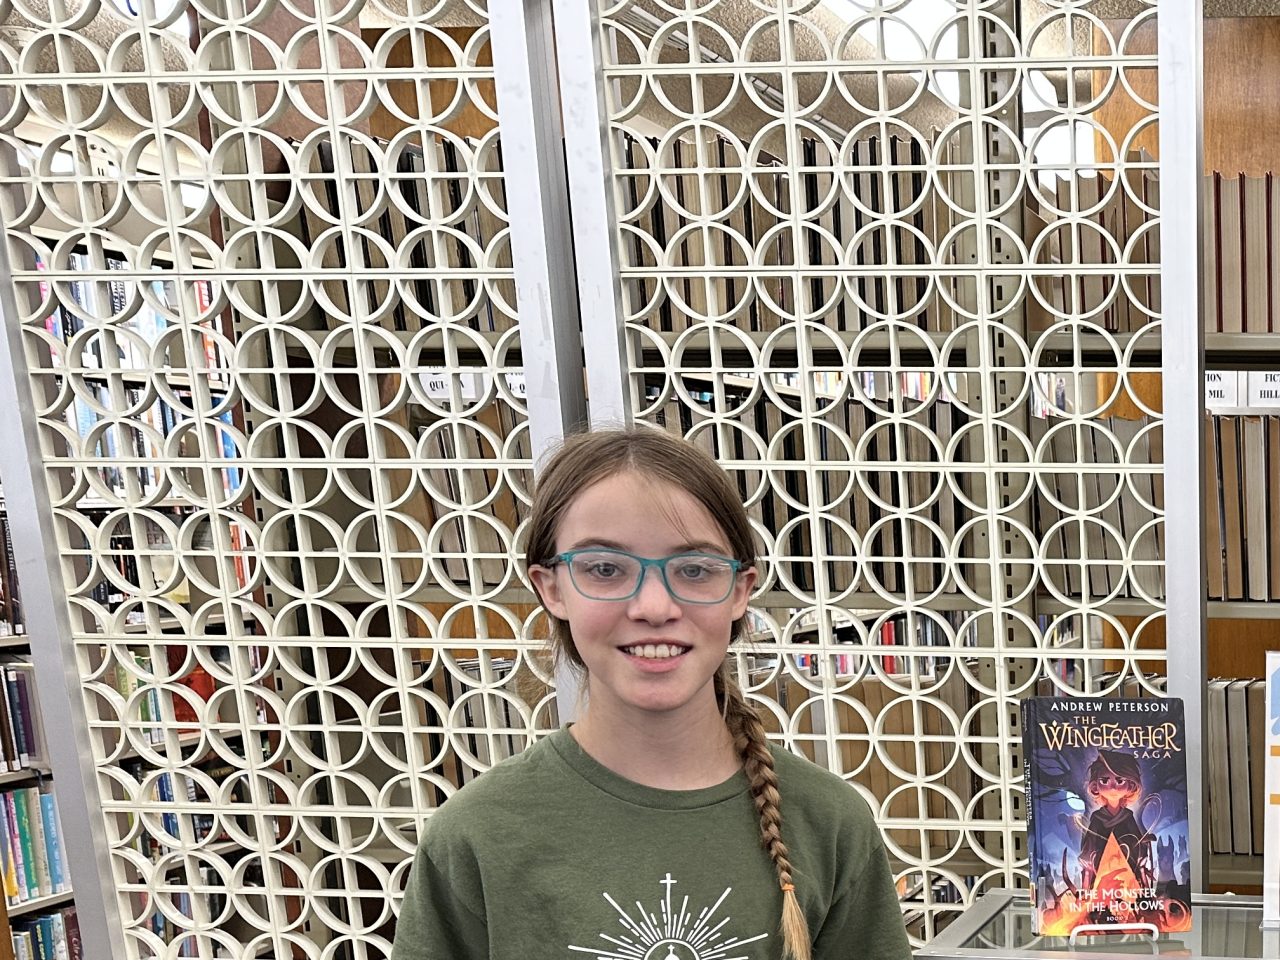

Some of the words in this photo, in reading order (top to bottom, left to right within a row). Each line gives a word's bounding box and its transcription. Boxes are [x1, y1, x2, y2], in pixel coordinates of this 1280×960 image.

[429, 381, 444, 391] QUI
[1208, 390, 1225, 399] MIL
[1260, 390, 1280, 399] HILL
[1051, 702, 1102, 712] ANDREW
[1109, 702, 1169, 712] PETERSON
[1074, 716, 1097, 725] THE
[1039, 720, 1181, 752] WINGFEATHER
[1134, 750, 1171, 759] SAGA
[1076, 889, 1098, 900] THE
[1102, 888, 1157, 899] MONSTER
[1069, 902, 1081, 912] IN
[1085, 902, 1106, 912] THE
[1109, 900, 1164, 912] HOLLOWS
